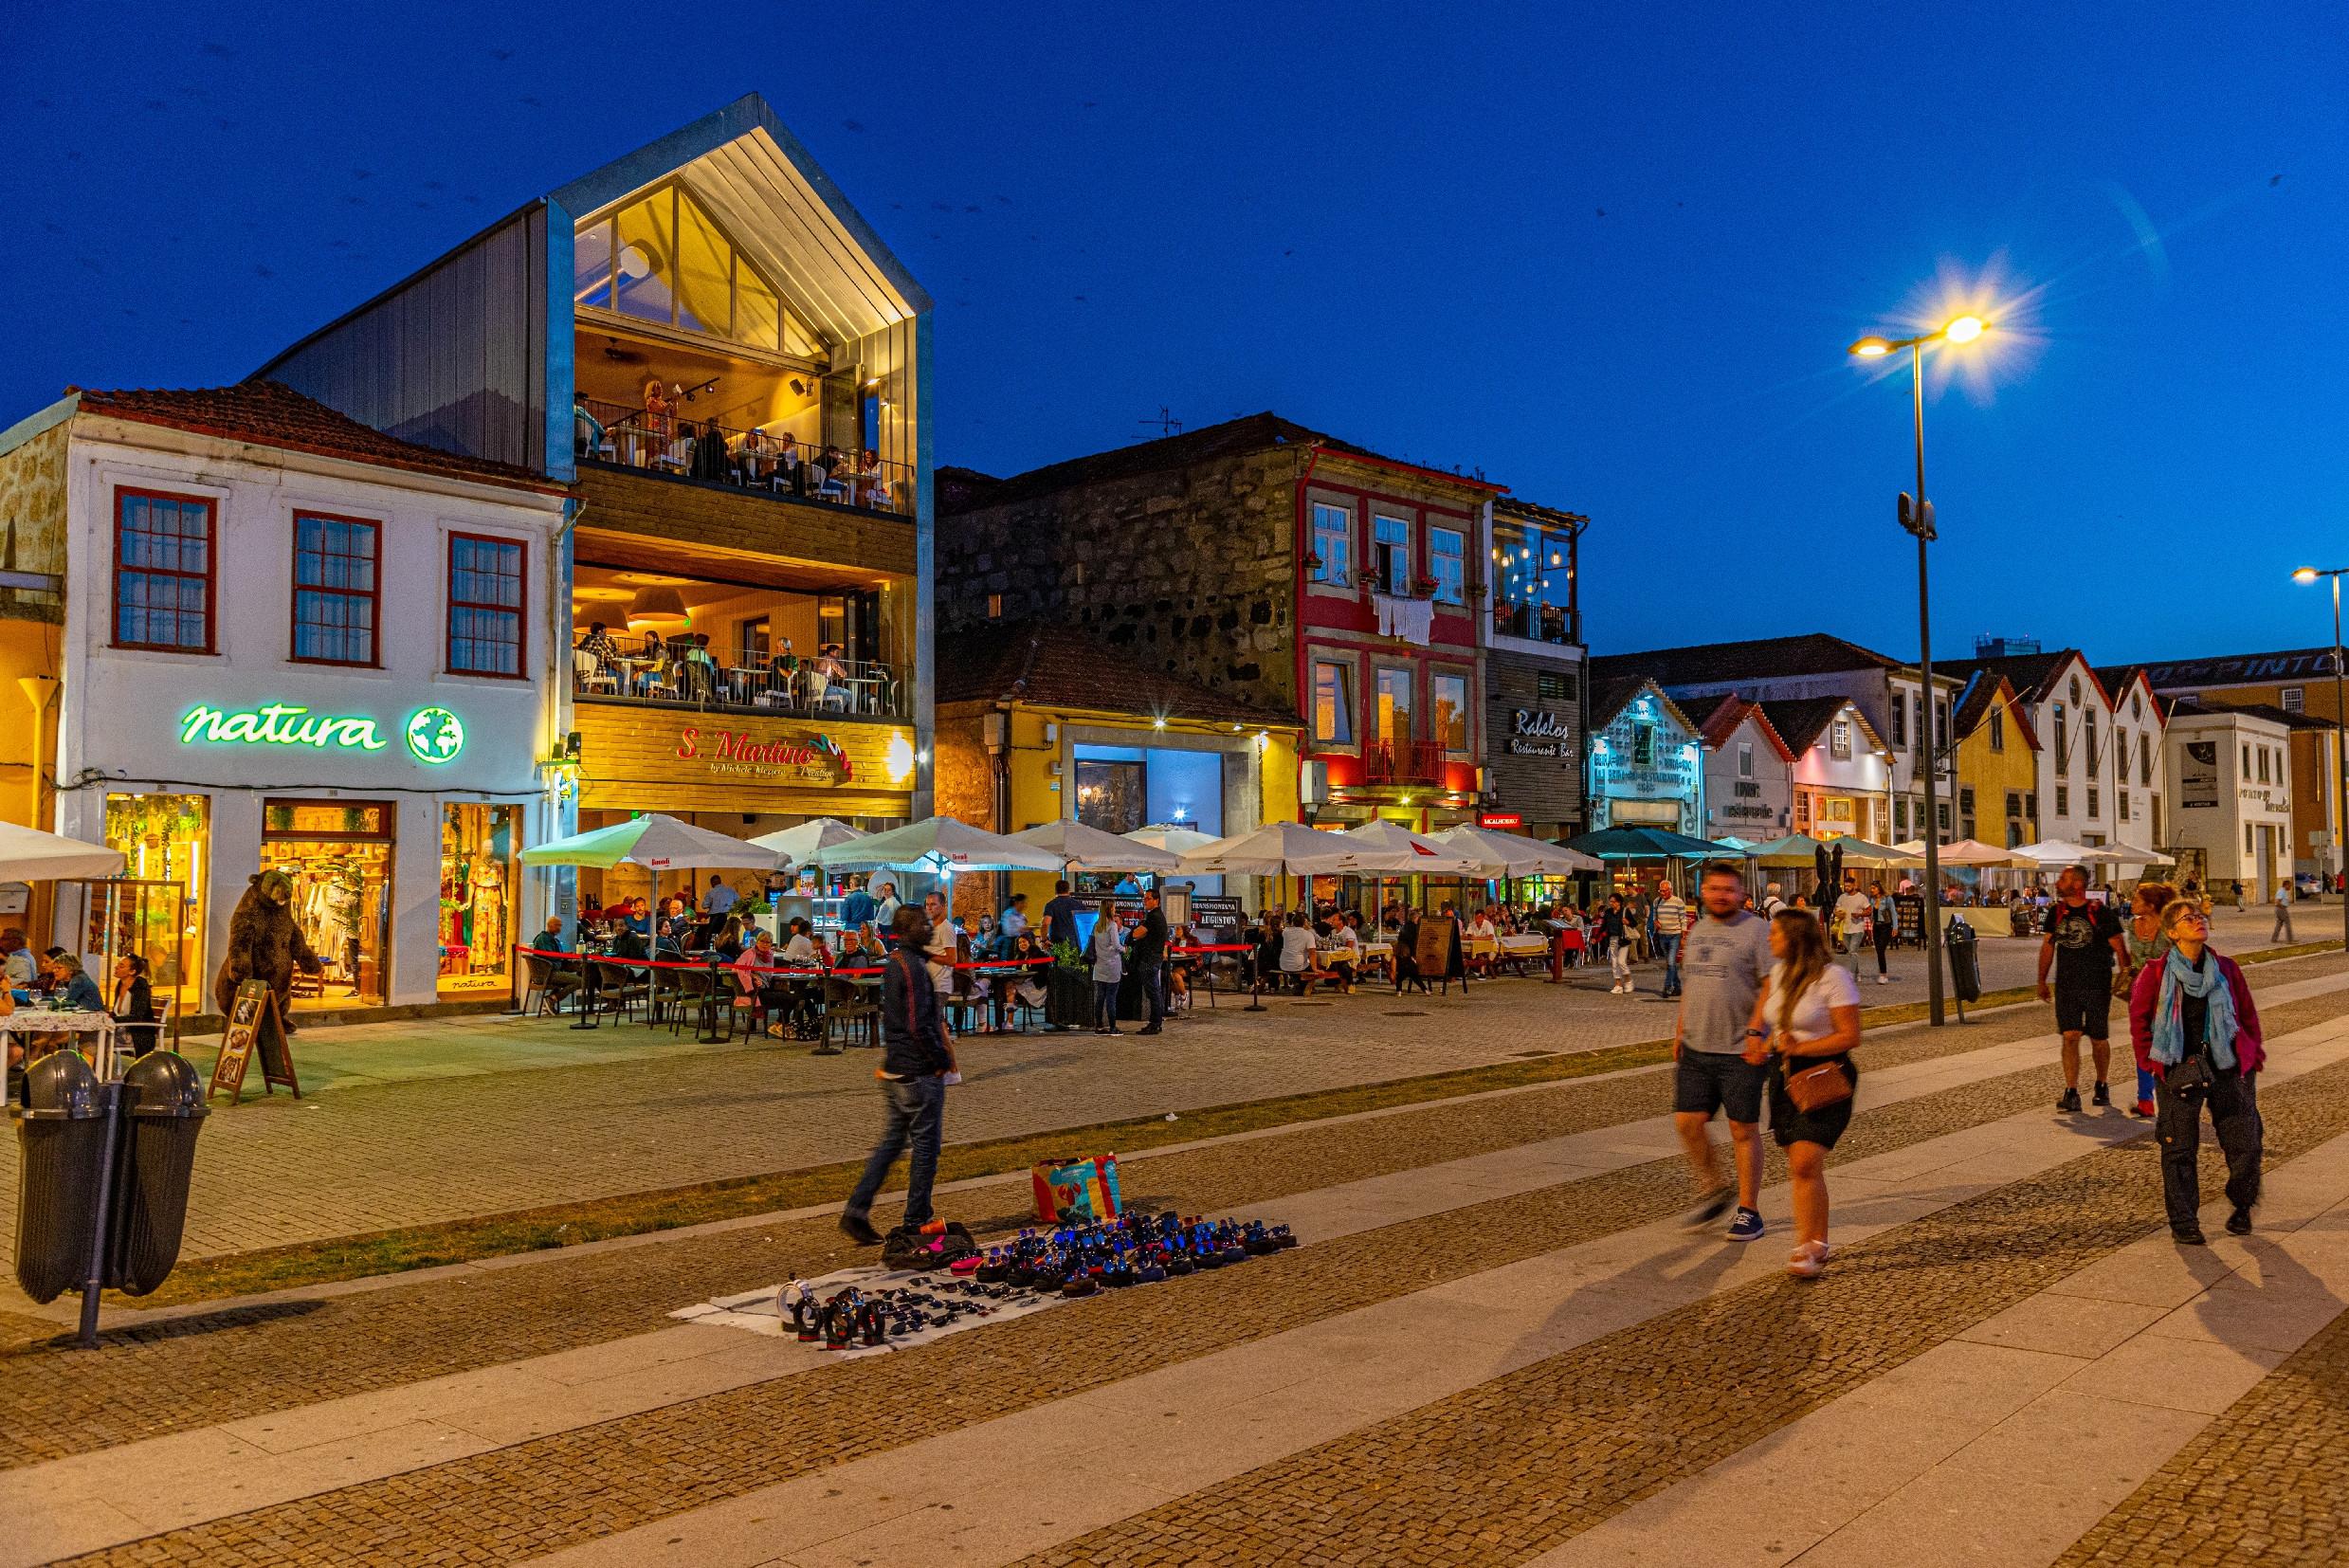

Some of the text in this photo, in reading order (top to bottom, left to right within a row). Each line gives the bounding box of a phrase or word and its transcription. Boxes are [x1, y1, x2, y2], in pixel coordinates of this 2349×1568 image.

[182, 702, 387, 750] natura
[1516, 709, 1569, 739] Rabelos
[677, 727, 815, 765] S. Martino
[1512, 738, 1575, 757] Restaurante Bar
[452, 979, 498, 989] natura
